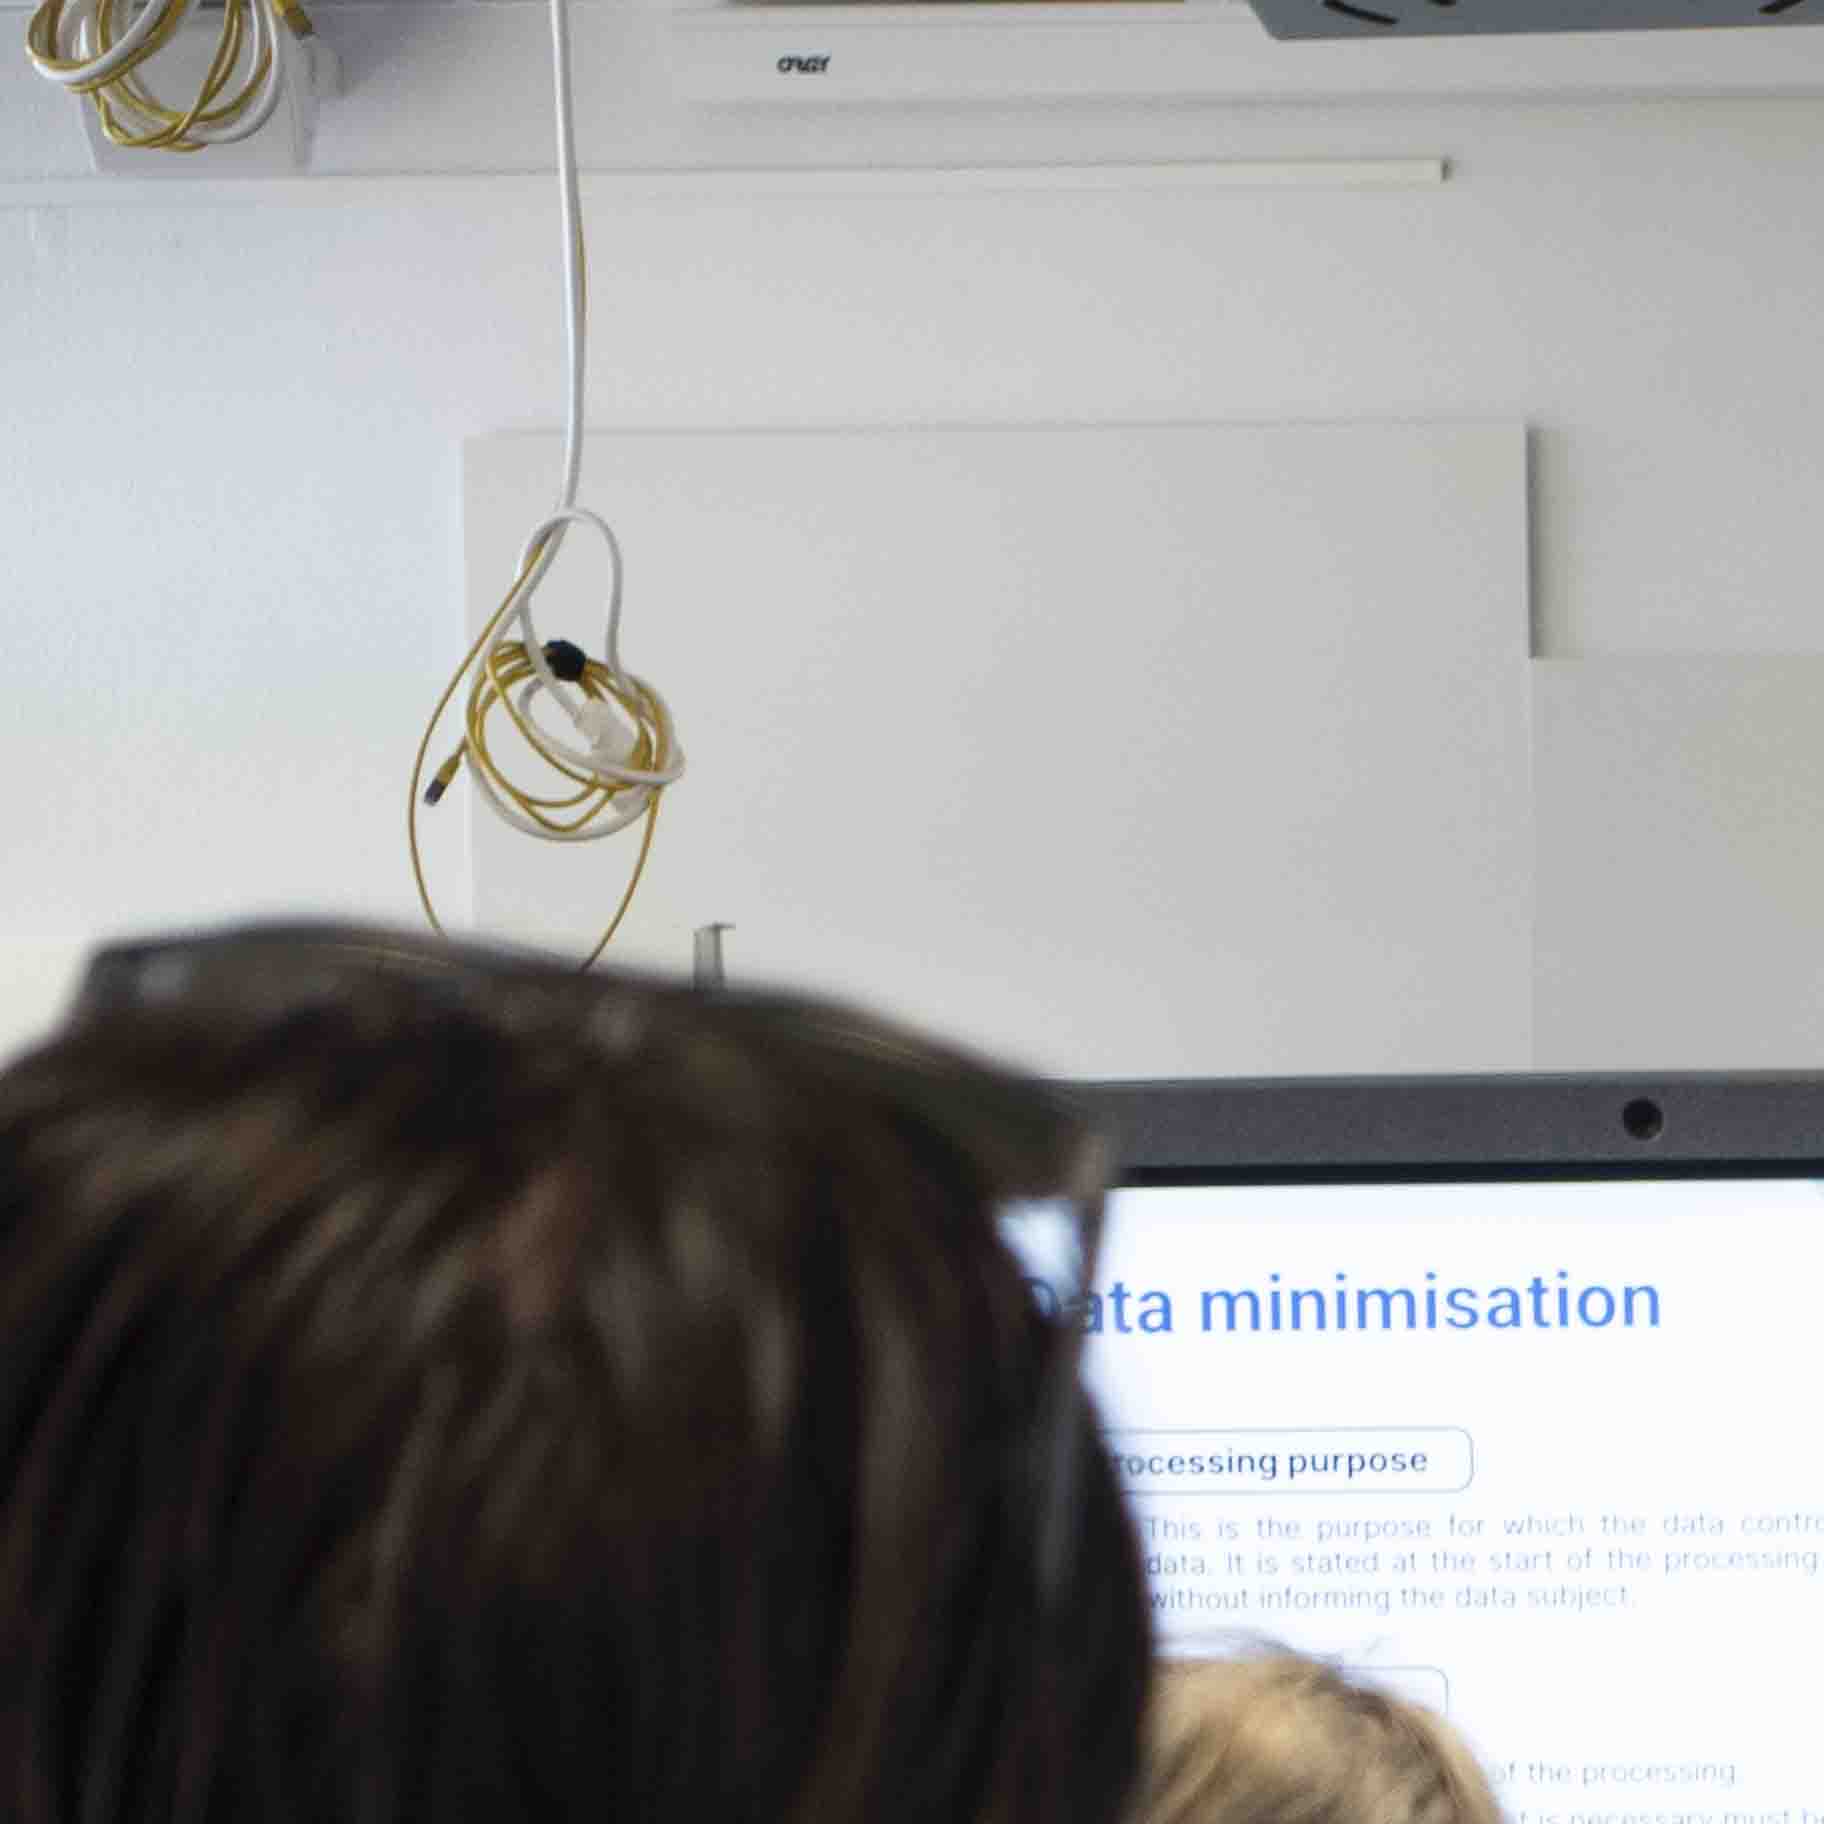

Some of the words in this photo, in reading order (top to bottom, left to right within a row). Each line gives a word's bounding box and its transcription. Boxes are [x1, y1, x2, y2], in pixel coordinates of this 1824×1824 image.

[1200, 1270, 1661, 1333] minimisation
[1108, 1450, 1278, 1481] rocessing
[1288, 1451, 1429, 1479] purpose
[1146, 1515, 1202, 1540] This
[1217, 1515, 1240, 1540] is
[1256, 1514, 1301, 1539] the
[1316, 1517, 1432, 1546] purpose
[1448, 1513, 1486, 1538] for
[1502, 1512, 1585, 1537] which
[1600, 1512, 1647, 1536] the
[1662, 1511, 1725, 1536] data
[1147, 1551, 1213, 1577] data.
[1227, 1551, 1246, 1576] It
[1256, 1550, 1279, 1576] is
[1292, 1549, 1379, 1575] stated
[1392, 1550, 1417, 1573] at
[1431, 1549, 1476, 1573] the
[1490, 1549, 1553, 1572] start
[1567, 1547, 1592, 1571] of
[1607, 1547, 1651, 1571] the
[1664, 1546, 1818, 1577] processing
[1149, 1585, 1249, 1611] without
[1260, 1585, 1391, 1614] informing
[1400, 1585, 1444, 1609] the
[1455, 1584, 1516, 1609] data
[1528, 1583, 1634, 1613] subject.
[1527, 1760, 1572, 1782] the
[1581, 1759, 1737, 1788] processing
